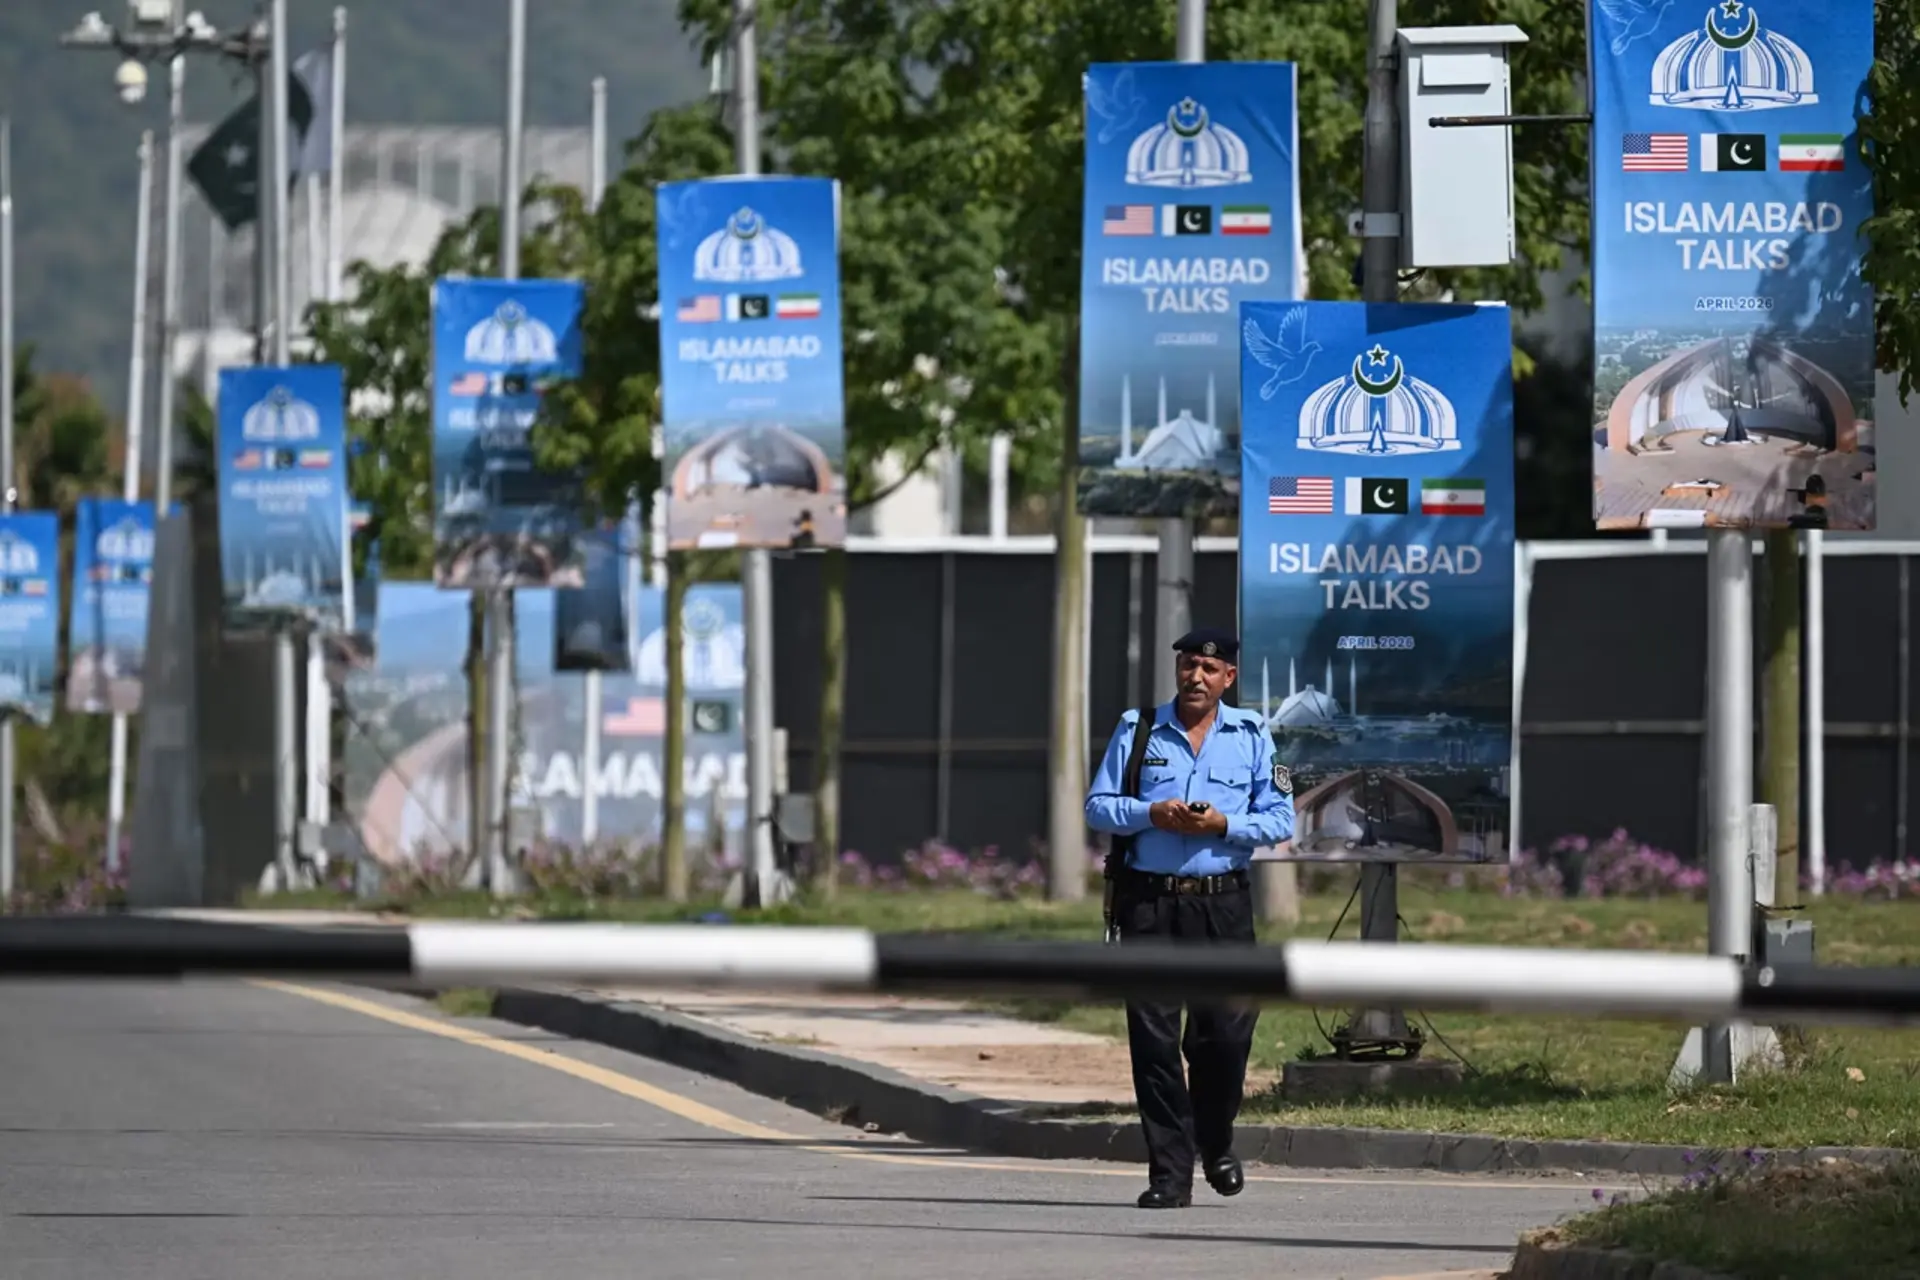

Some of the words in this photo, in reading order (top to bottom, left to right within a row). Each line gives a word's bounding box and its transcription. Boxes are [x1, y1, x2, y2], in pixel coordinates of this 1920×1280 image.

[1623, 202, 1843, 234] ISLAMABAD
[1675, 239, 1790, 271] TALKS
[1103, 257, 1270, 285] ISLAMABAD
[1143, 287, 1230, 313] TALKS
[1694, 296, 1735, 311] APRIL
[1737, 296, 1774, 311] 2026
[678, 333, 822, 362] ISLAMABAD
[714, 359, 788, 384] TALKS
[1269, 542, 1483, 575] ISLAMABAD
[1319, 579, 1431, 610] TALKS
[1336, 635, 1378, 650] APRIL
